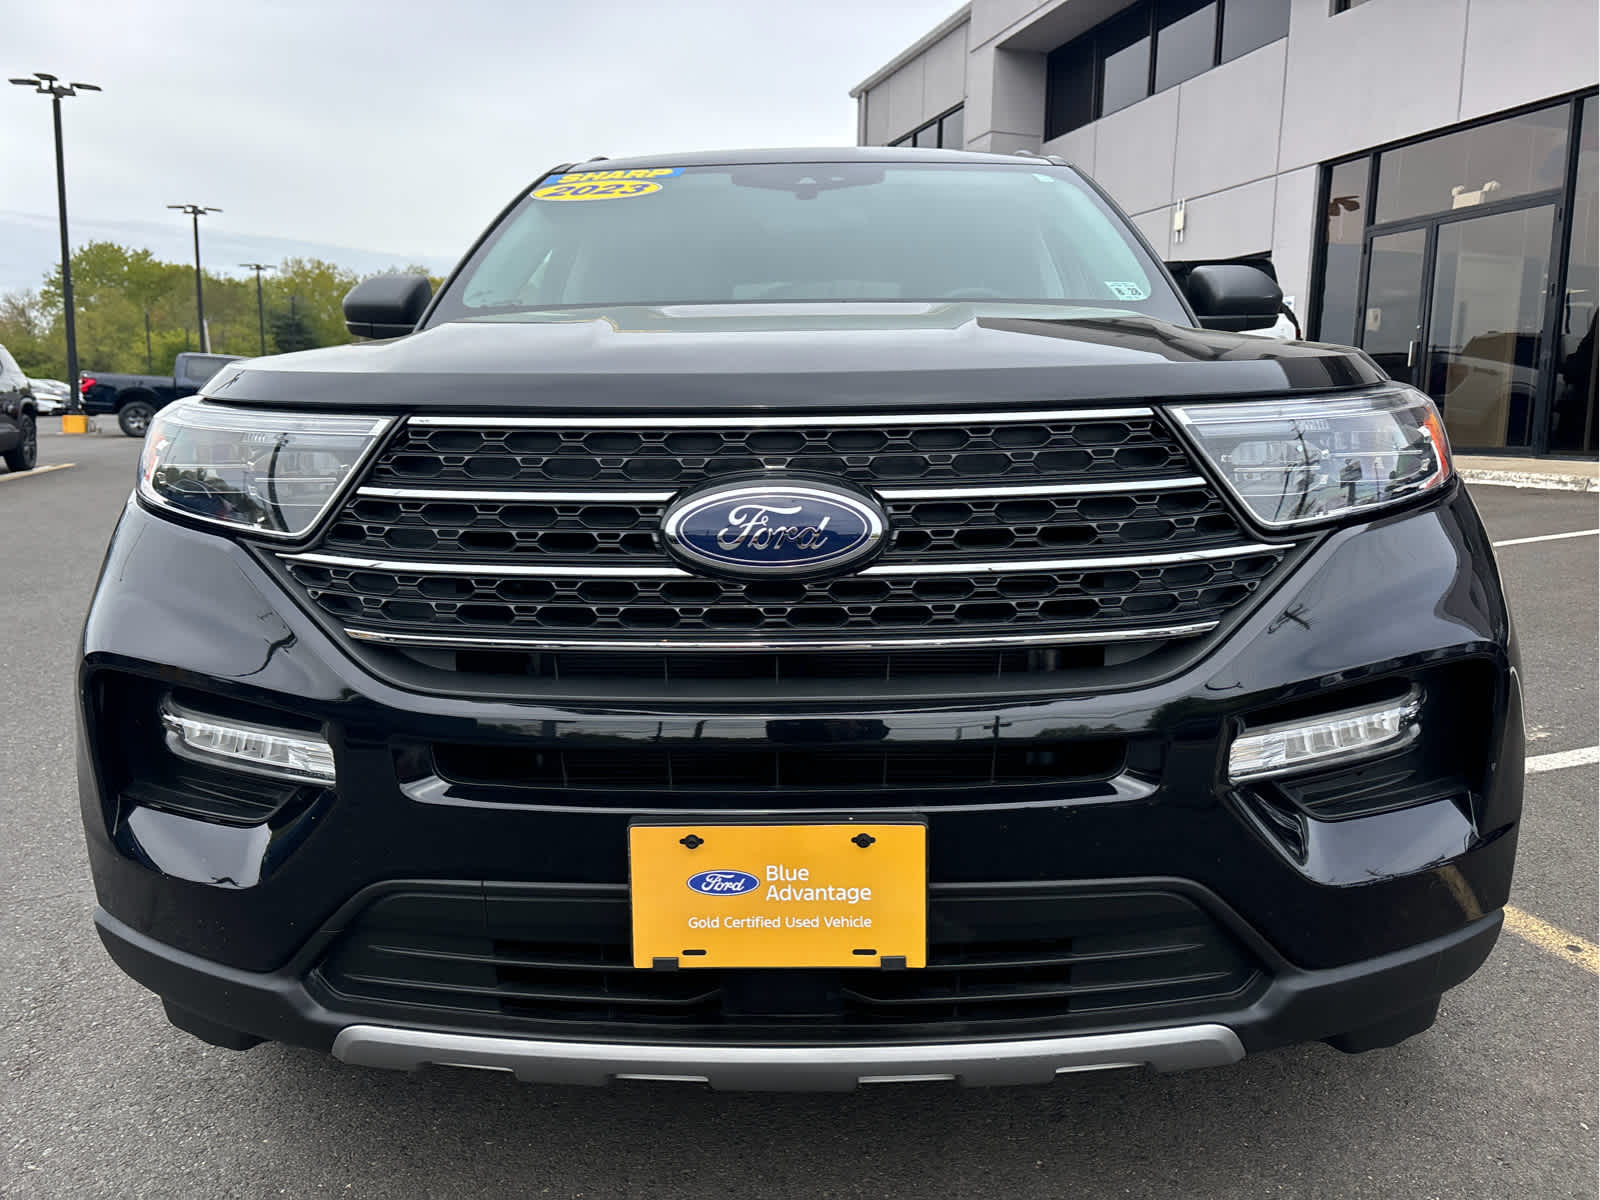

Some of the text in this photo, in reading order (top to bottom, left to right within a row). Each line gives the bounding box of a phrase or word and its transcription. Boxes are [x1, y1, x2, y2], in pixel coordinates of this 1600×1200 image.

[557, 168, 674, 184] SHARP
[542, 183, 650, 198] 2023
[716, 503, 831, 551] Ford
[765, 864, 809, 881] Blue
[700, 872, 747, 892] Ford
[765, 884, 872, 904] Advantage
[687, 915, 873, 929] Gold Certified Used Vehicle
